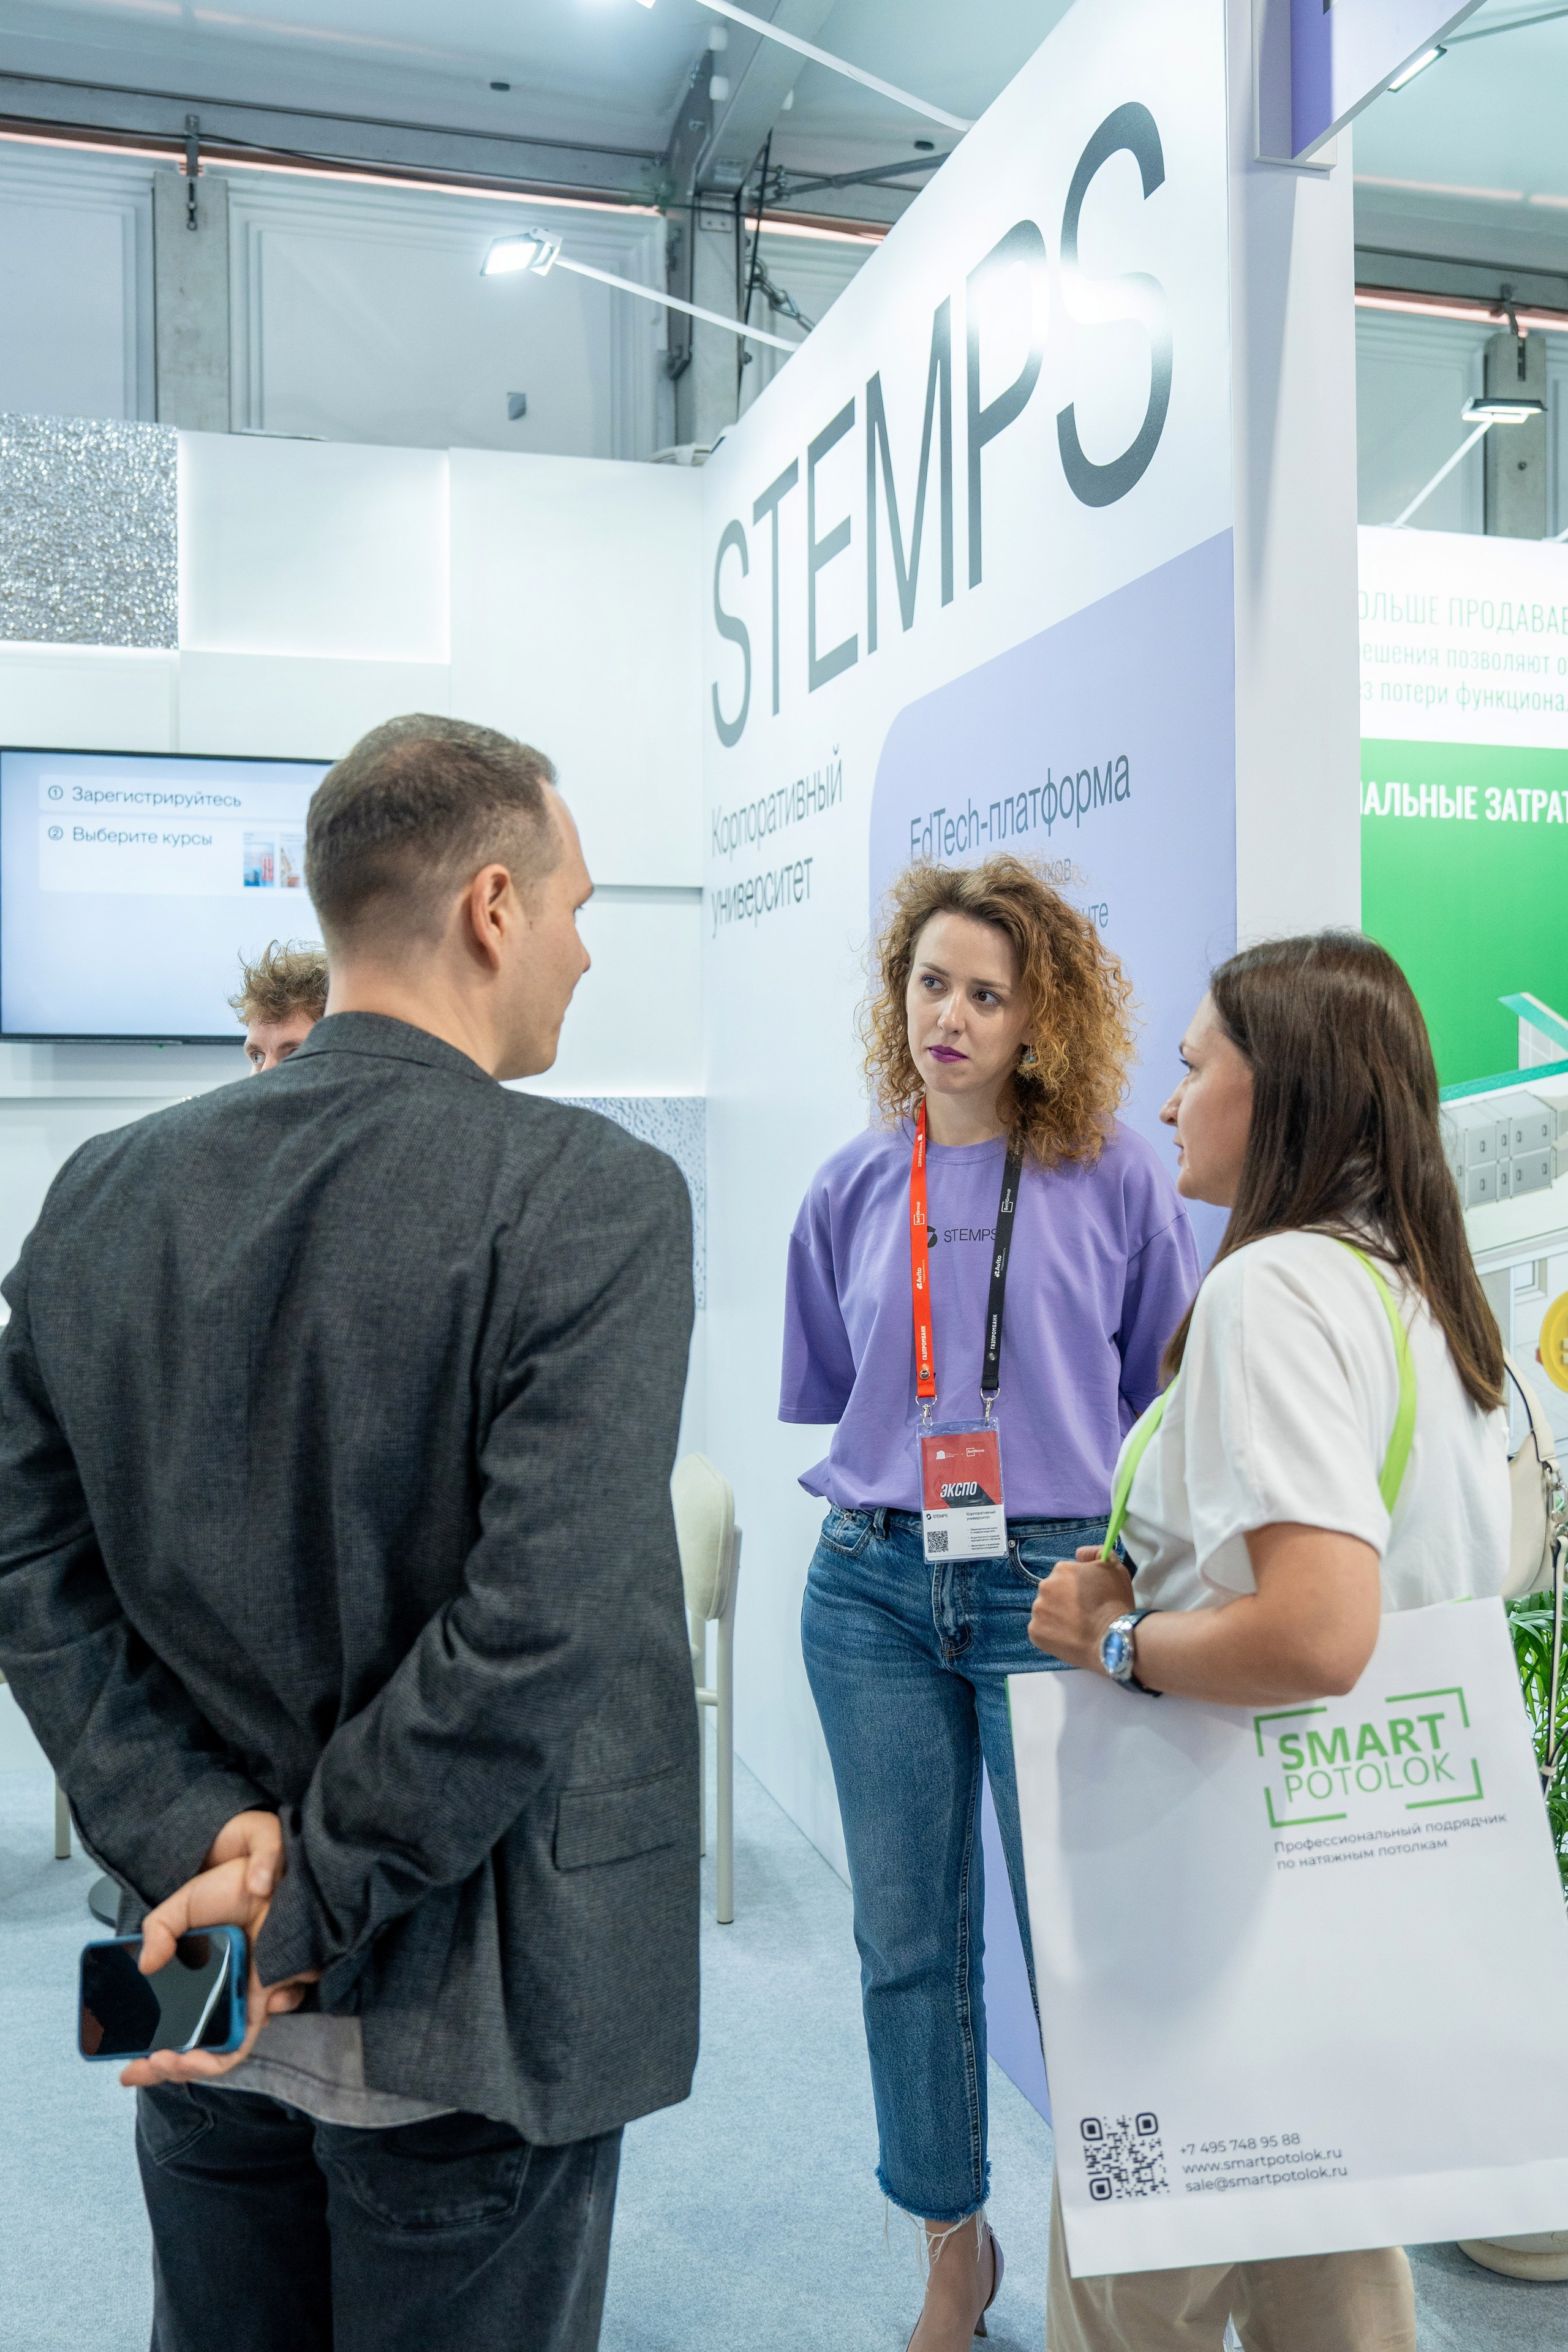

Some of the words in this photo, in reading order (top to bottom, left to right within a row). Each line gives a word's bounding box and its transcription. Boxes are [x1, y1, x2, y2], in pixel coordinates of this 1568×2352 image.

[711, 101, 1173, 748] STEMPS
[1447, 649, 1549, 674] позволяют
[1558, 657, 1568, 676] о
[1381, 682, 1448, 709] потери
[1456, 680, 1568, 714] функциона
[72, 786, 242, 808] Зарегистрируйтесь
[711, 743, 842, 862] Корпоративный
[910, 754, 1131, 861] EdTech-платформа
[1360, 781, 1478, 820] АЛЬНЫЕ
[73, 826, 157, 845] Выберите
[162, 833, 213, 847] курсы
[711, 857, 813, 938] университет
[944, 1228, 997, 1243] STEMPS
[940, 1481, 978, 1498] ЭКСПО
[1278, 1712, 1446, 1771] SMART
[1284, 1752, 1455, 1803] POTOLOK
[1275, 1822, 1421, 1853] Профессиональный
[1425, 1813, 1508, 1833] подрядчик
[1277, 1860, 1294, 1870] по
[1299, 1849, 1374, 1868] натяжным
[1378, 1838, 1449, 1856] потолкам
[1180, 2143, 1195, 2155] +7
[1200, 2140, 1226, 2154] 495
[1229, 2137, 1256, 2150] 748
[1260, 2135, 1278, 2148] 95
[1281, 2132, 1300, 2145] 88
[1182, 2149, 1343, 2174] www.smartpotolok.ru
[1185, 2166, 1348, 2192] sale@smartpotolok.ru
